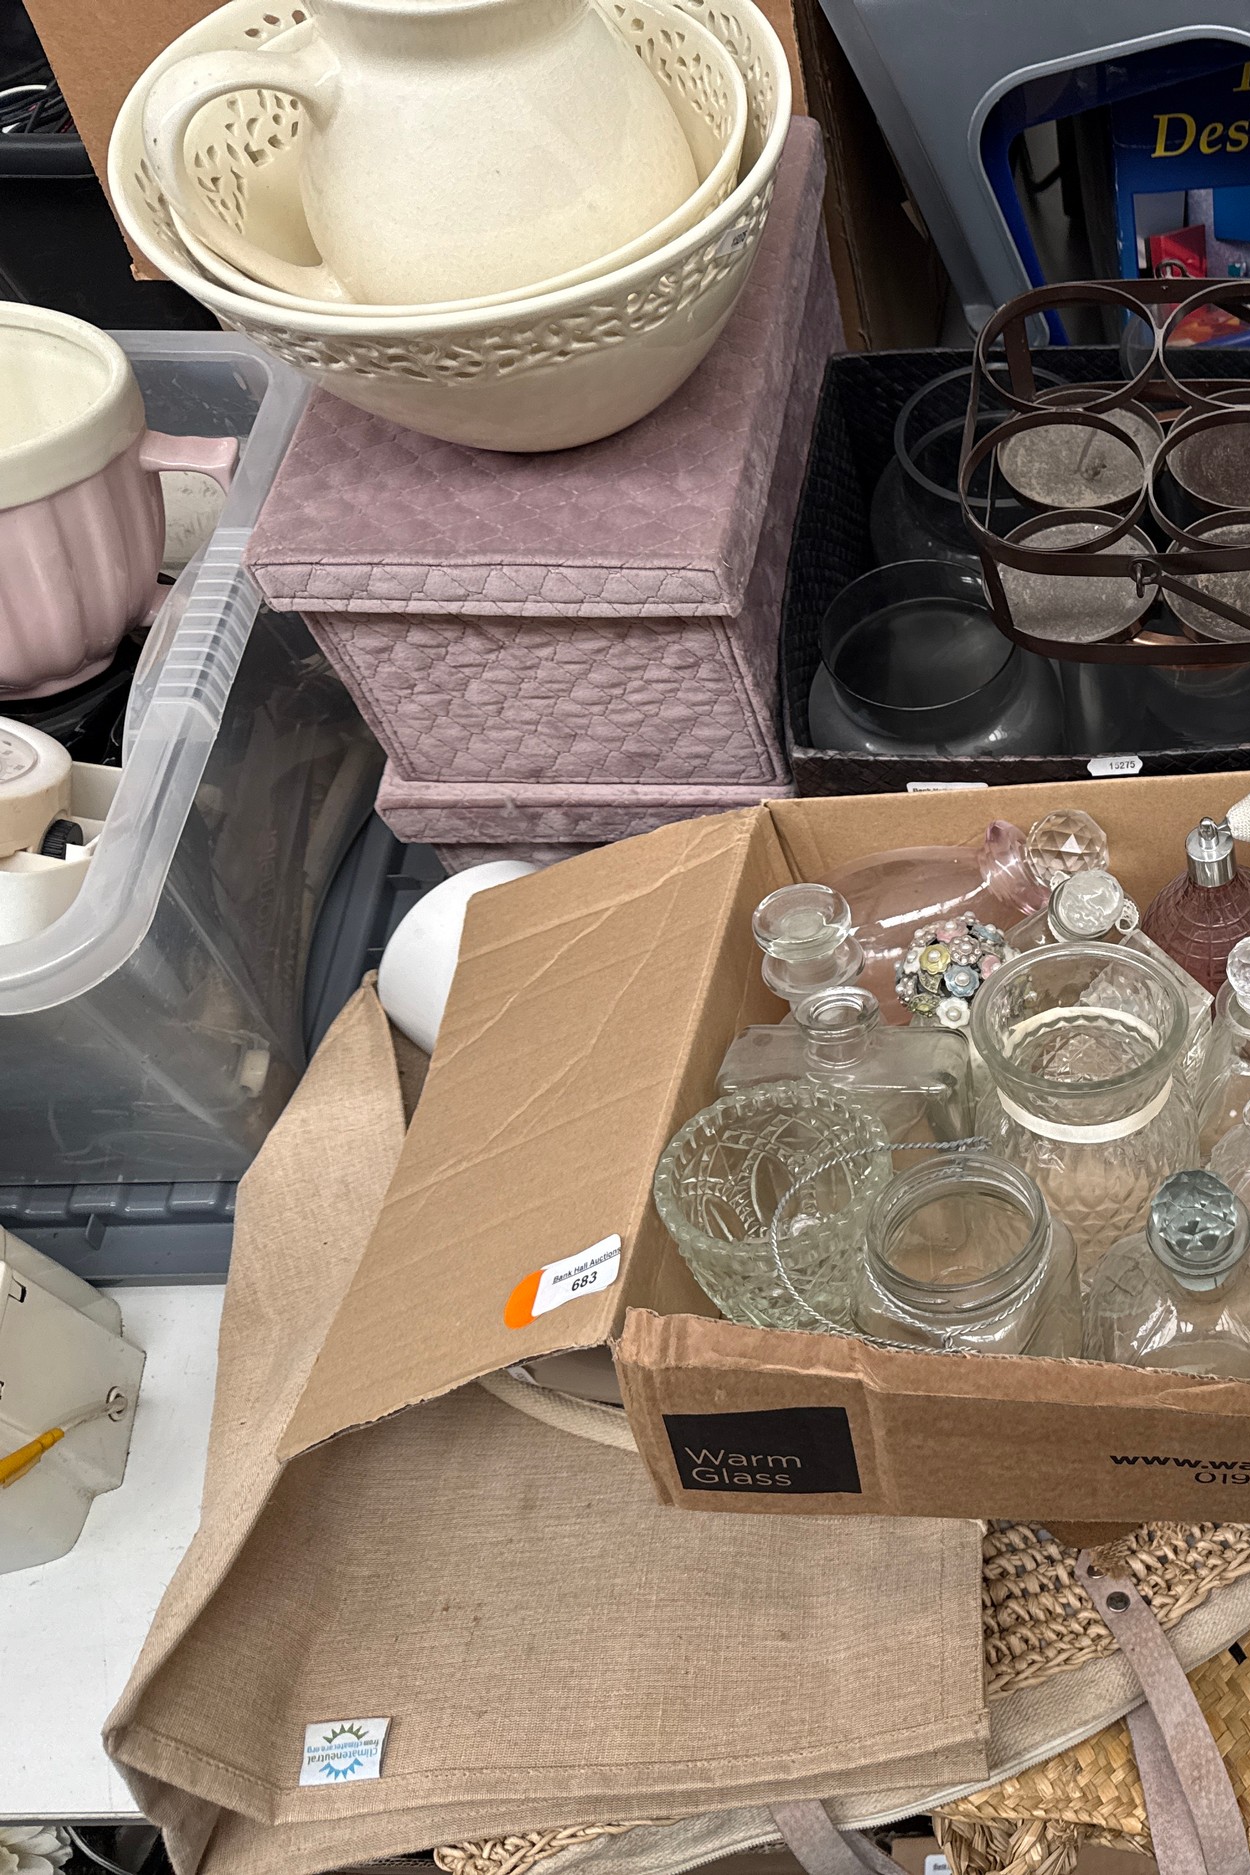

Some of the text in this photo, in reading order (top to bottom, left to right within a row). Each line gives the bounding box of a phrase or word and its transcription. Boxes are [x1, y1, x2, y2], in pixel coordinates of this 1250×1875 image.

[551, 1247, 622, 1285] Bank Hall Auctions
[571, 1271, 598, 1292] 683
[684, 1447, 802, 1469] Warm
[691, 1467, 793, 1487] Glass
[363, 1739, 380, 1749] from
[307, 1747, 378, 1765] climateneutral
